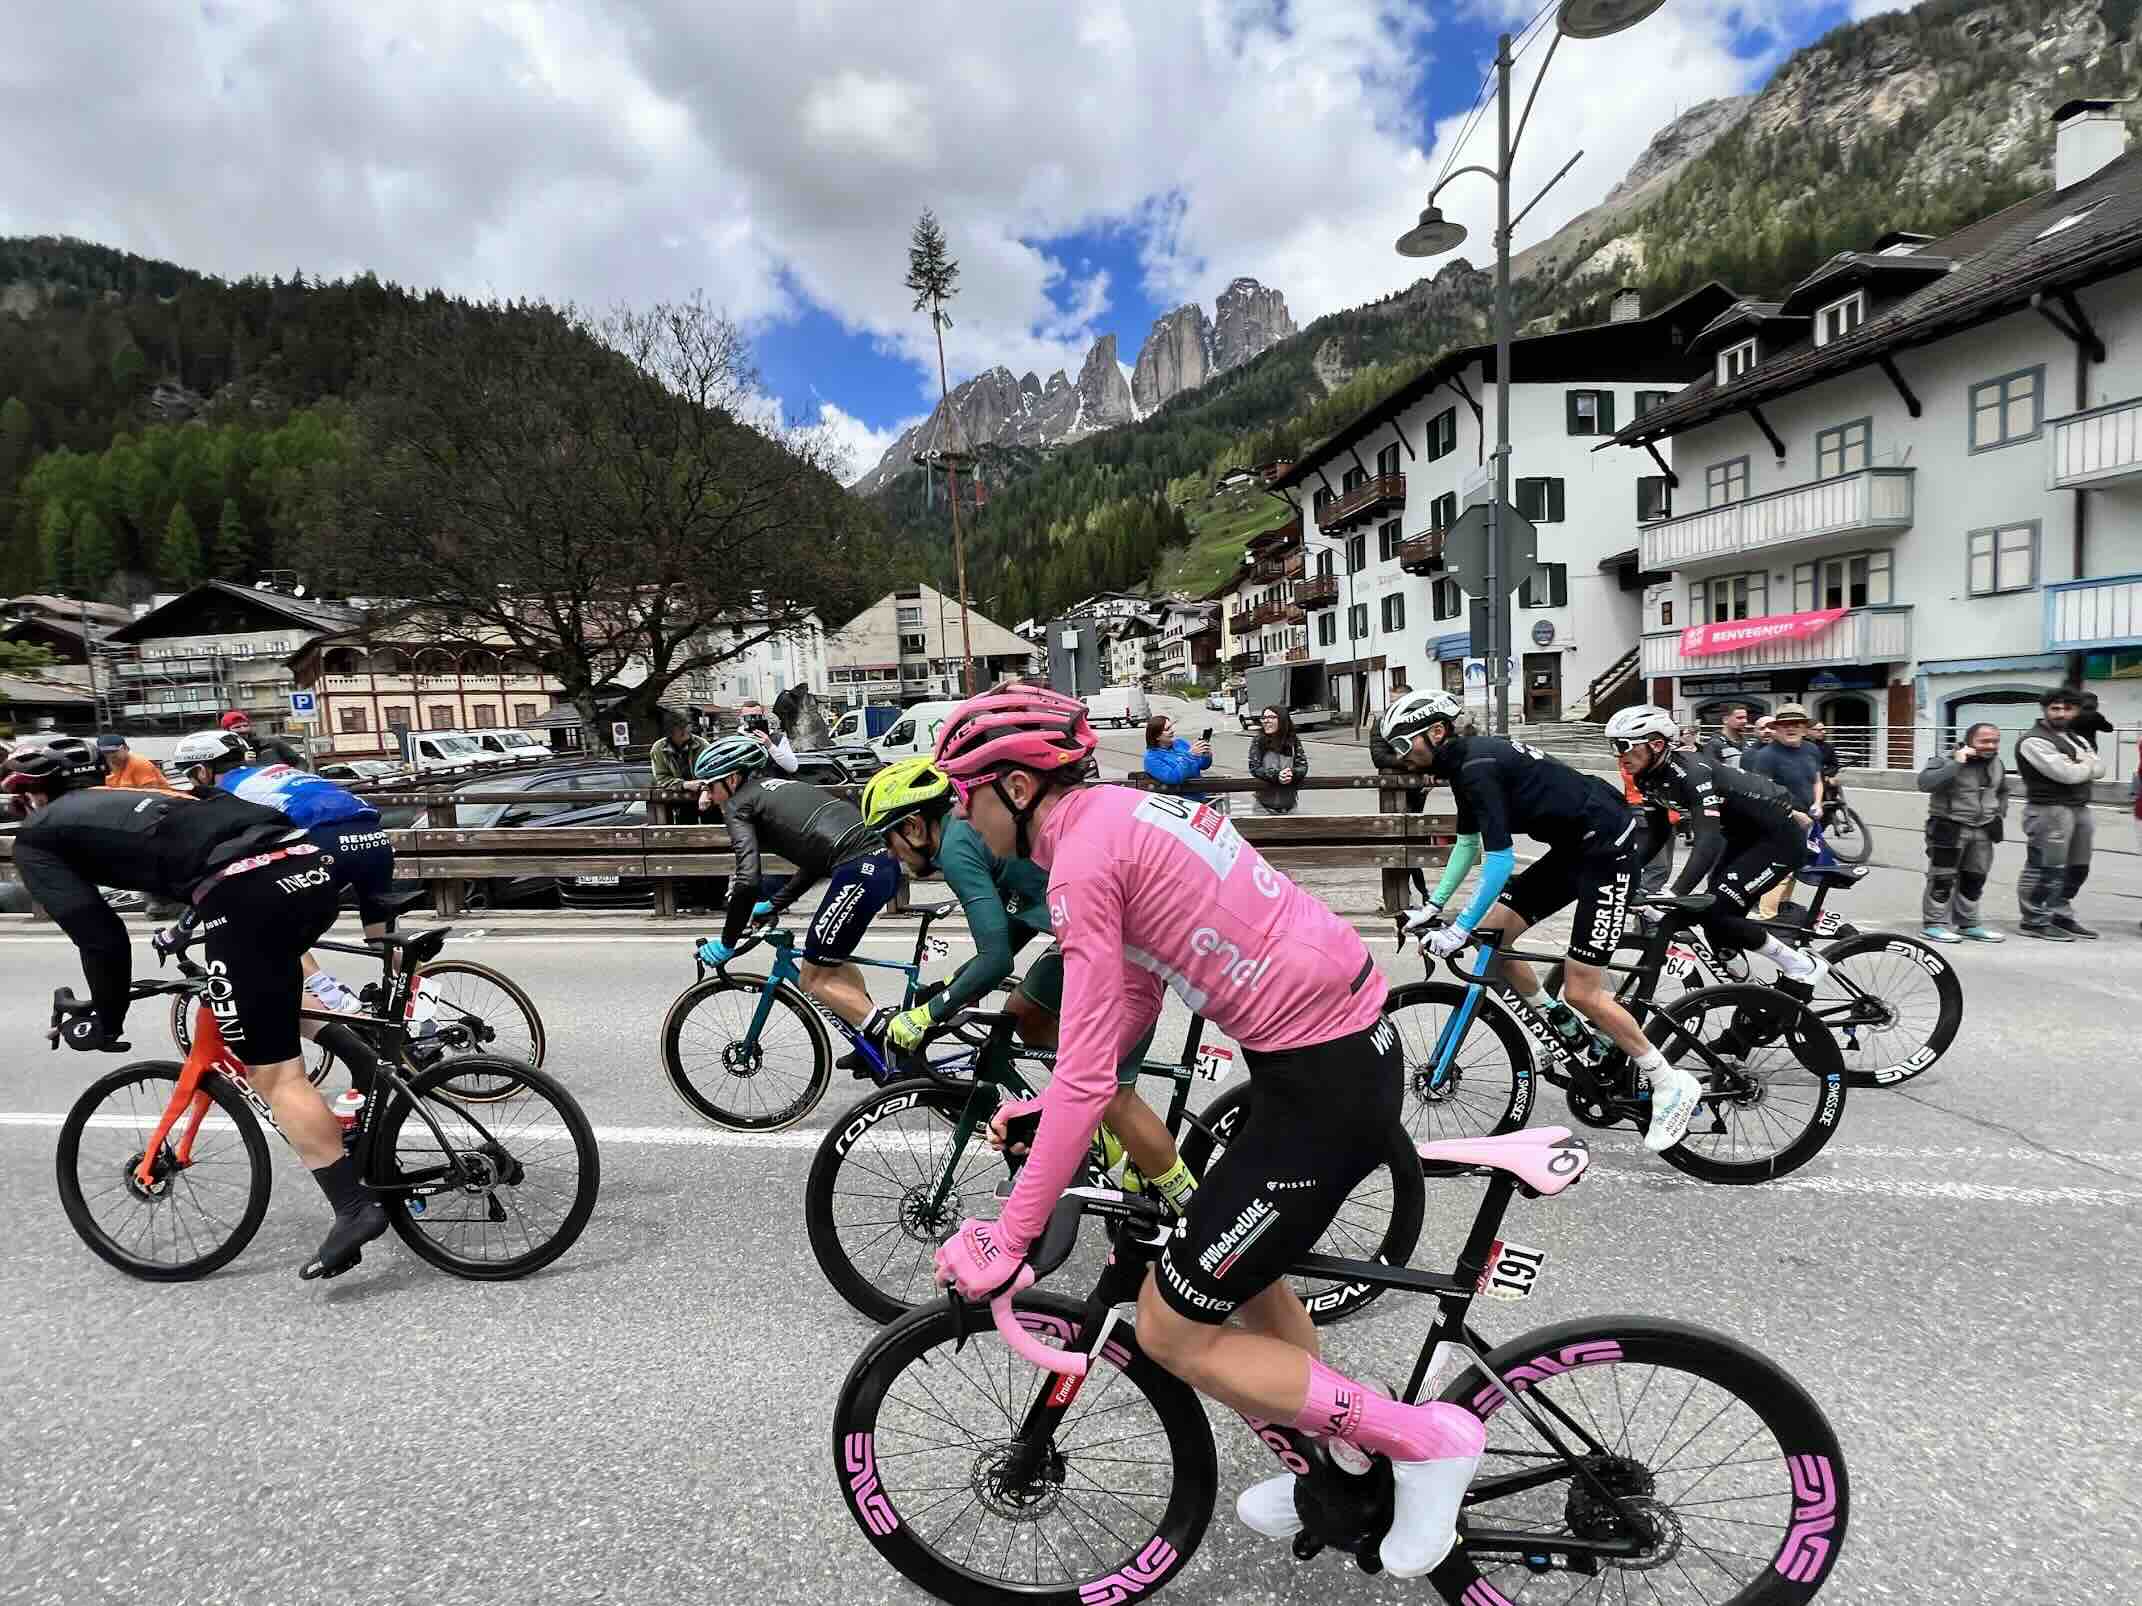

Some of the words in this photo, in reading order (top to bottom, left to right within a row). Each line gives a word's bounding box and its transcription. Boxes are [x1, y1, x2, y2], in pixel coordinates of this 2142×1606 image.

[297, 695, 309, 709] P
[274, 867, 332, 895] INEOS
[1598, 884, 1615, 910] LA
[814, 884, 857, 939] ASTANA
[1587, 909, 1615, 951] AG2R
[1606, 872, 1631, 952] MONDIALE
[1819, 911, 1841, 933] 196
[1667, 957, 1687, 977] 64
[207, 959, 247, 1042] INEOS
[418, 991, 438, 1004] 2
[1500, 988, 1534, 1021] VAN
[1530, 1019, 1575, 1066] RYSEL
[212, 1059, 275, 1124] DOGM
[834, 1092, 919, 1156] roval
[1279, 1179, 1317, 1190] PISSEI
[974, 1226, 1001, 1263] UAE
[1199, 1198, 1270, 1272] #WeAreUAE
[1161, 1246, 1237, 1312] Emirates
[1492, 1248, 1545, 1295] 191
